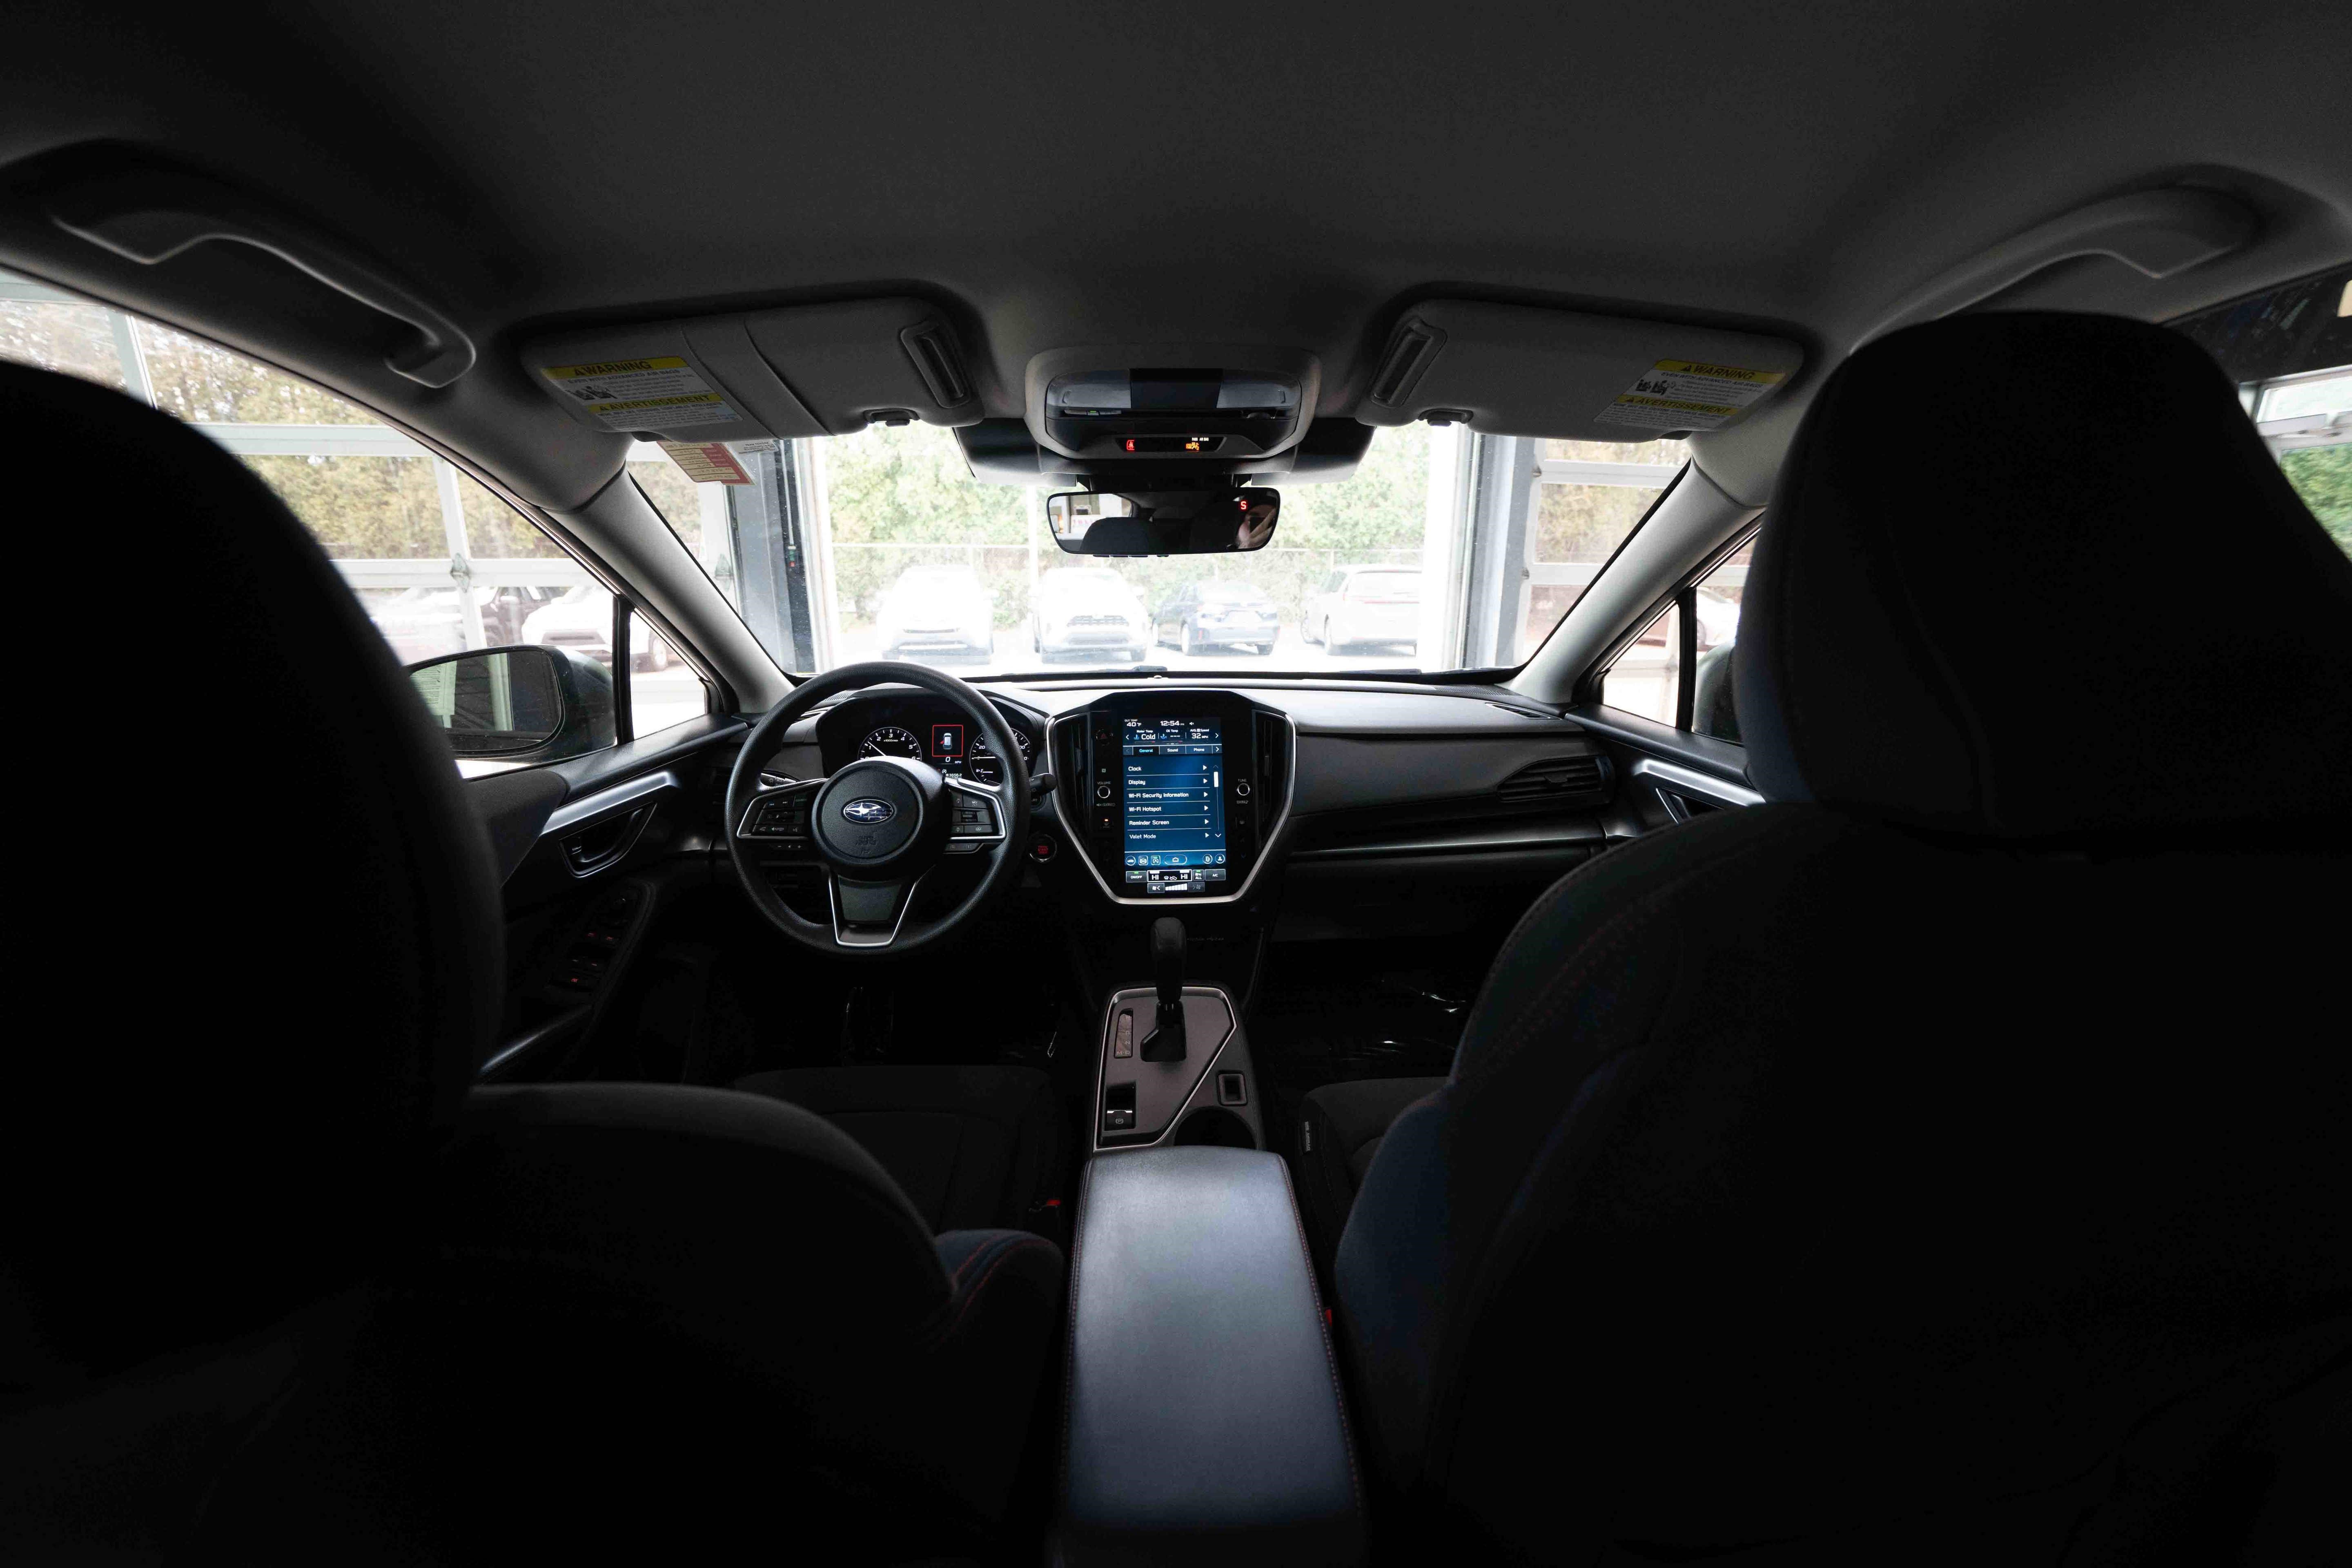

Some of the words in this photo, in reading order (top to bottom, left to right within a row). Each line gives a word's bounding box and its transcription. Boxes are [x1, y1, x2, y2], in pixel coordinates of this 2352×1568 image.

[583, 361, 652, 375] WARNING
[1693, 365, 1756, 379] WARNING
[609, 394, 710, 410] AVERTISSEMENT
[1636, 397, 1732, 414] AVERTISSEMENT
[1241, 501, 1247, 510] S
